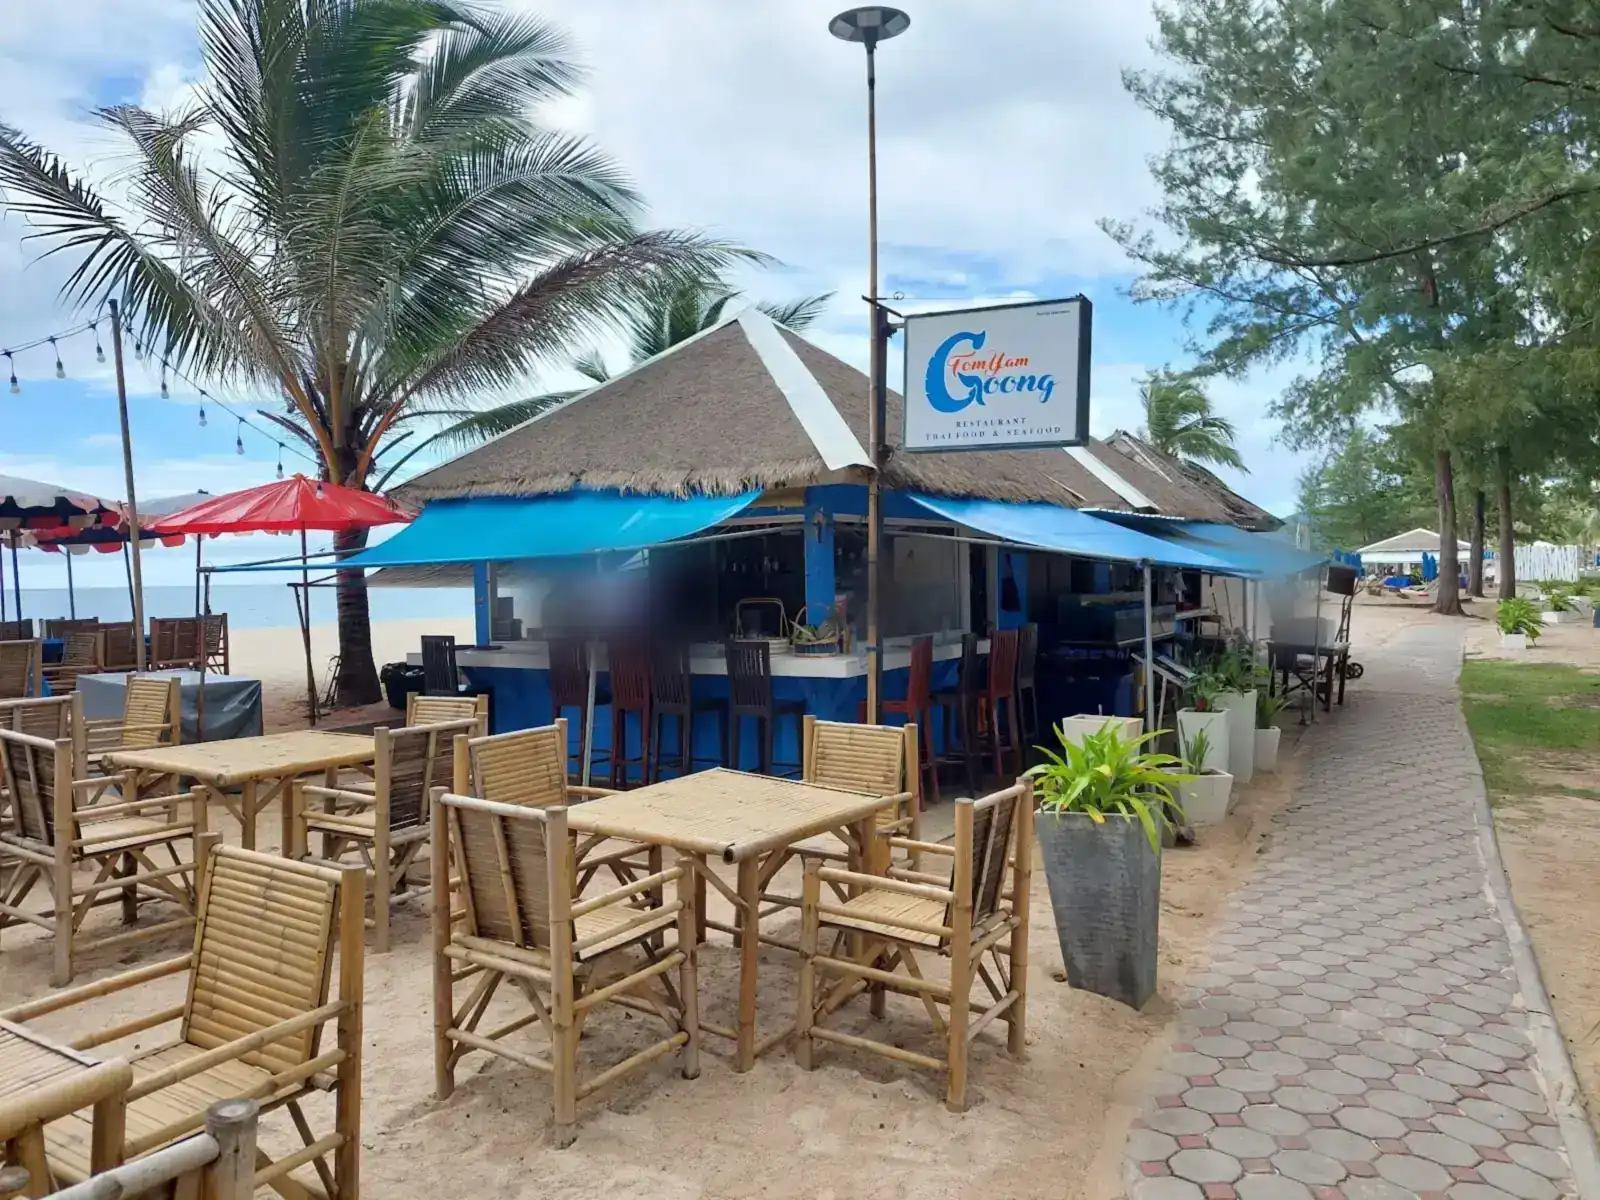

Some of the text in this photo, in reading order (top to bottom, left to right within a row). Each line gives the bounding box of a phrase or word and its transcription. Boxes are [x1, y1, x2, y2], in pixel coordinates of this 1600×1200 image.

[925, 330, 1060, 413] Goong
[955, 417, 1027, 428] RESTAURANT
[992, 429, 999, 437] &
[1006, 425, 1062, 436] SEAFOOD
